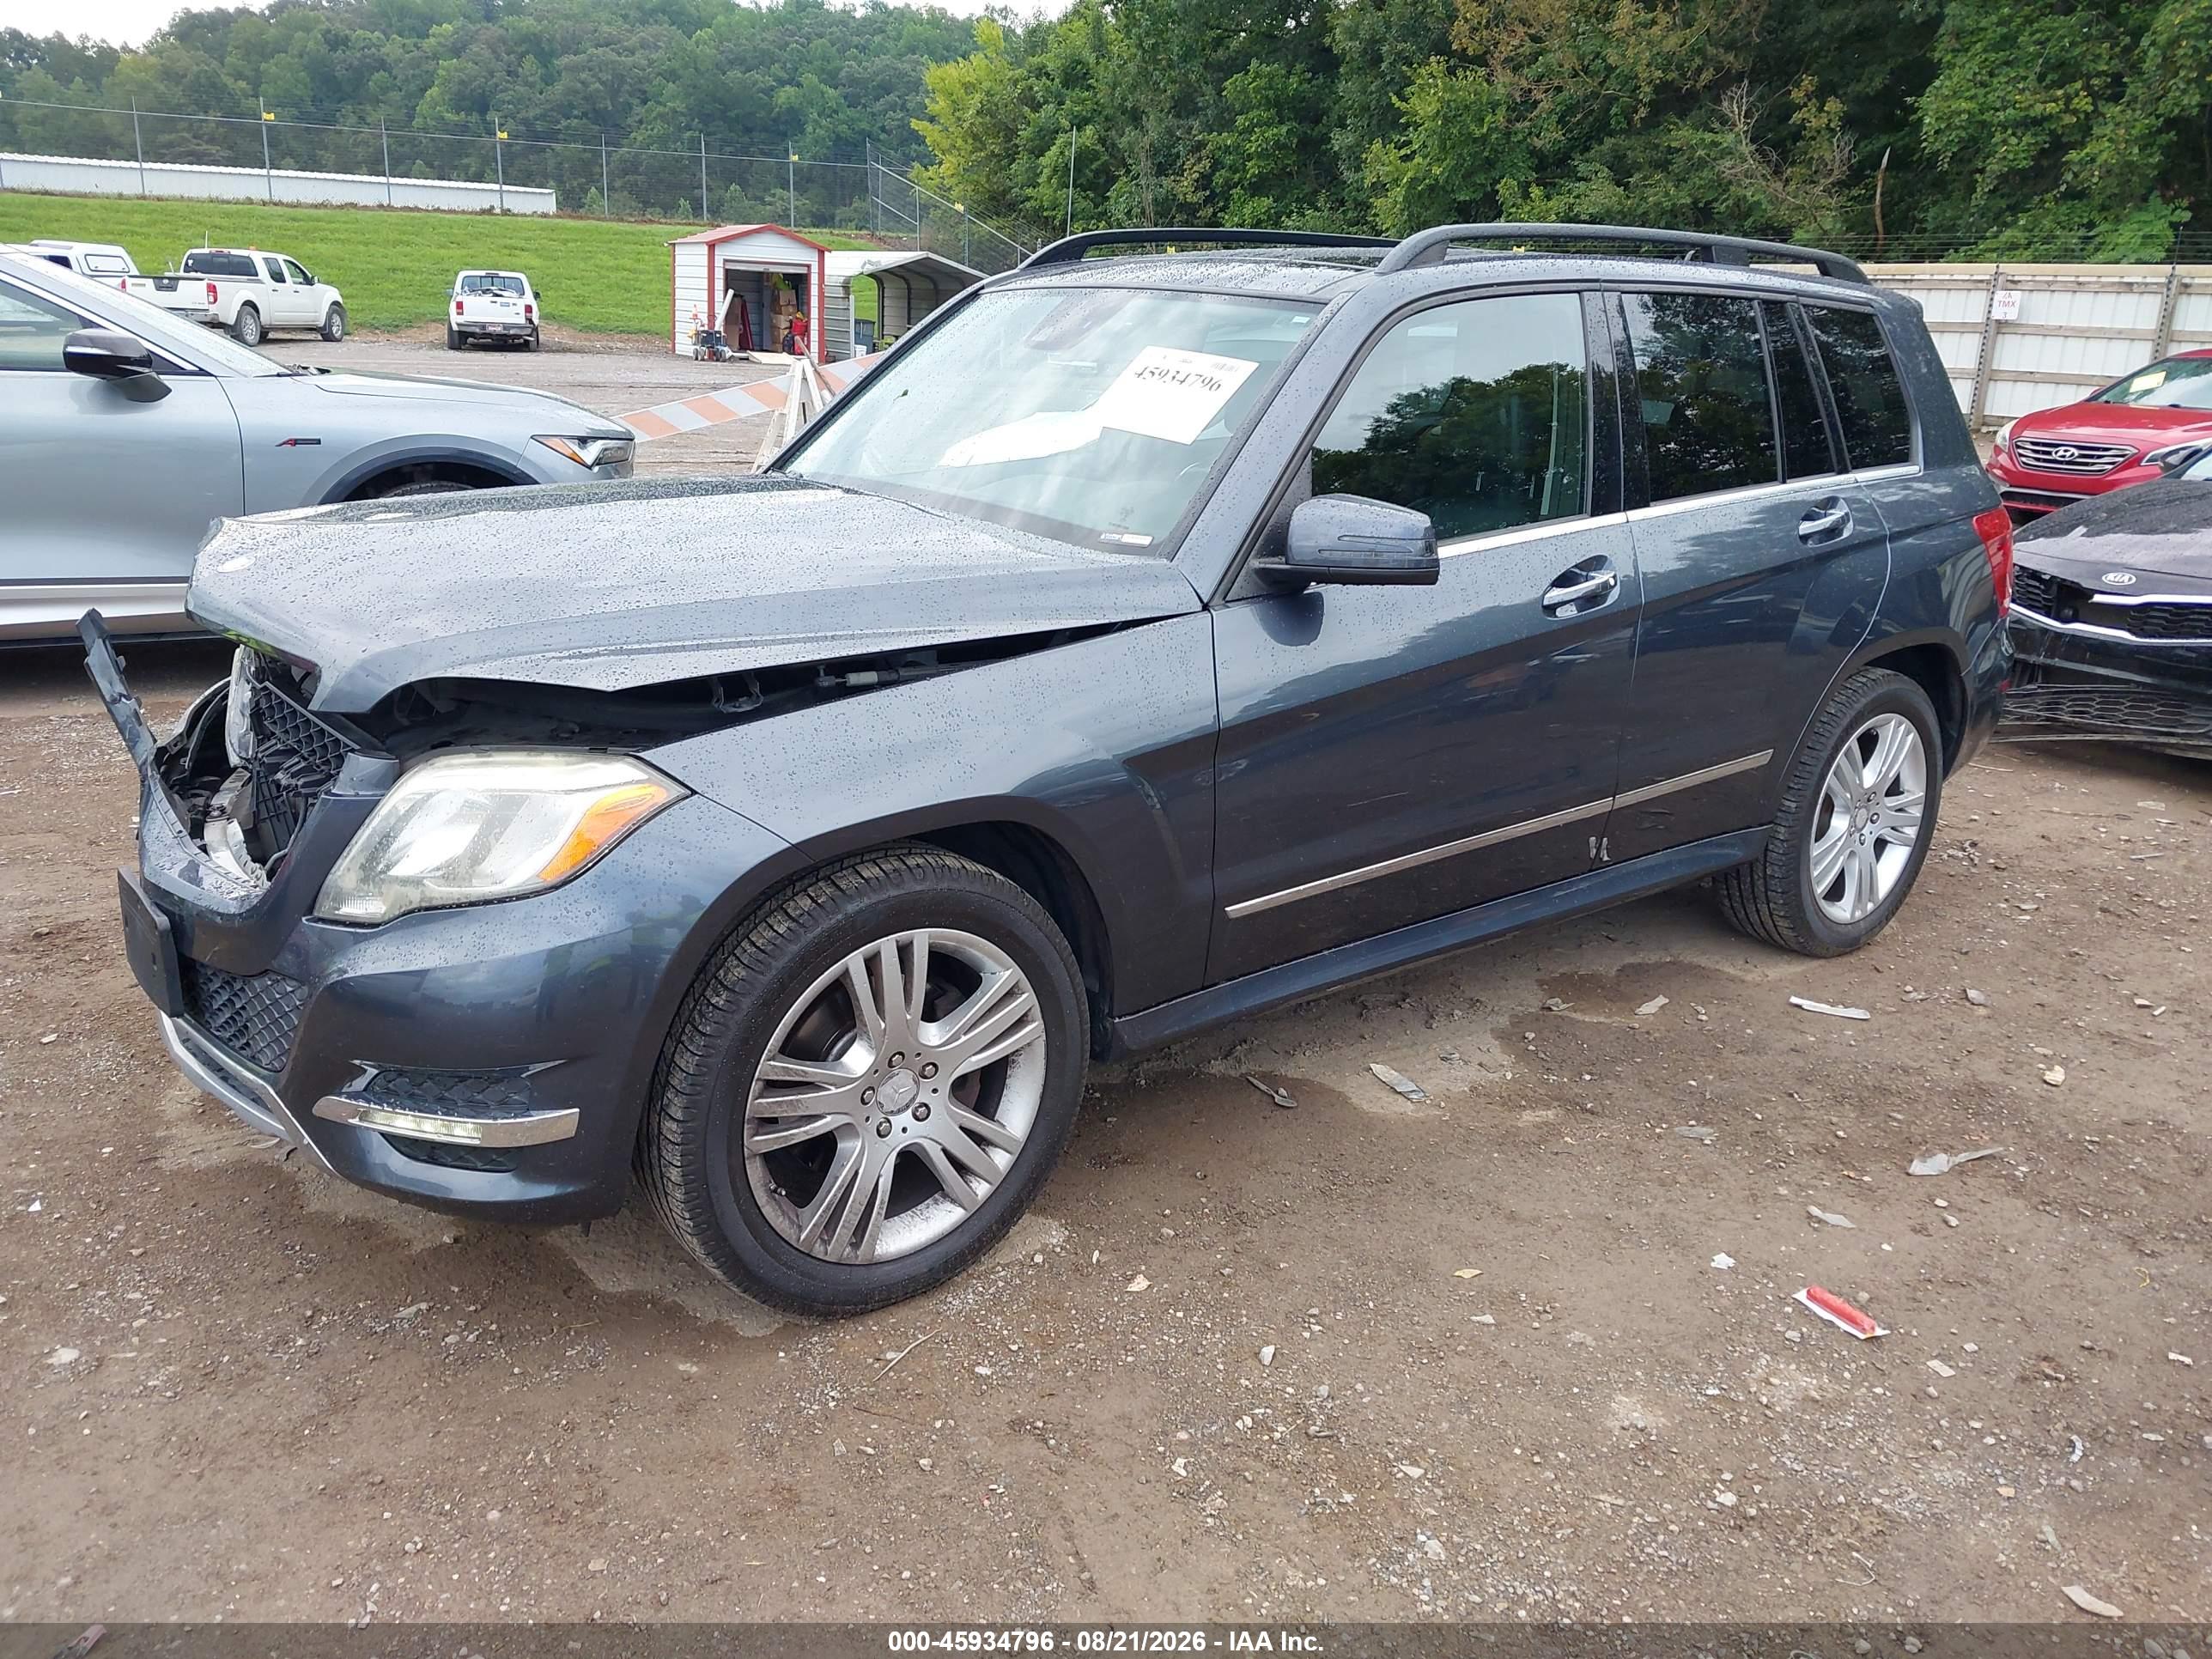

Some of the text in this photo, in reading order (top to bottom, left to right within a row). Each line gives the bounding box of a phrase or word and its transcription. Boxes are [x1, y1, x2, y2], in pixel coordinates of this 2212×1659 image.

[1997, 300, 2016, 308] TMX
[1134, 365, 1224, 392] 45934796
[2104, 573, 2134, 584] KIA
